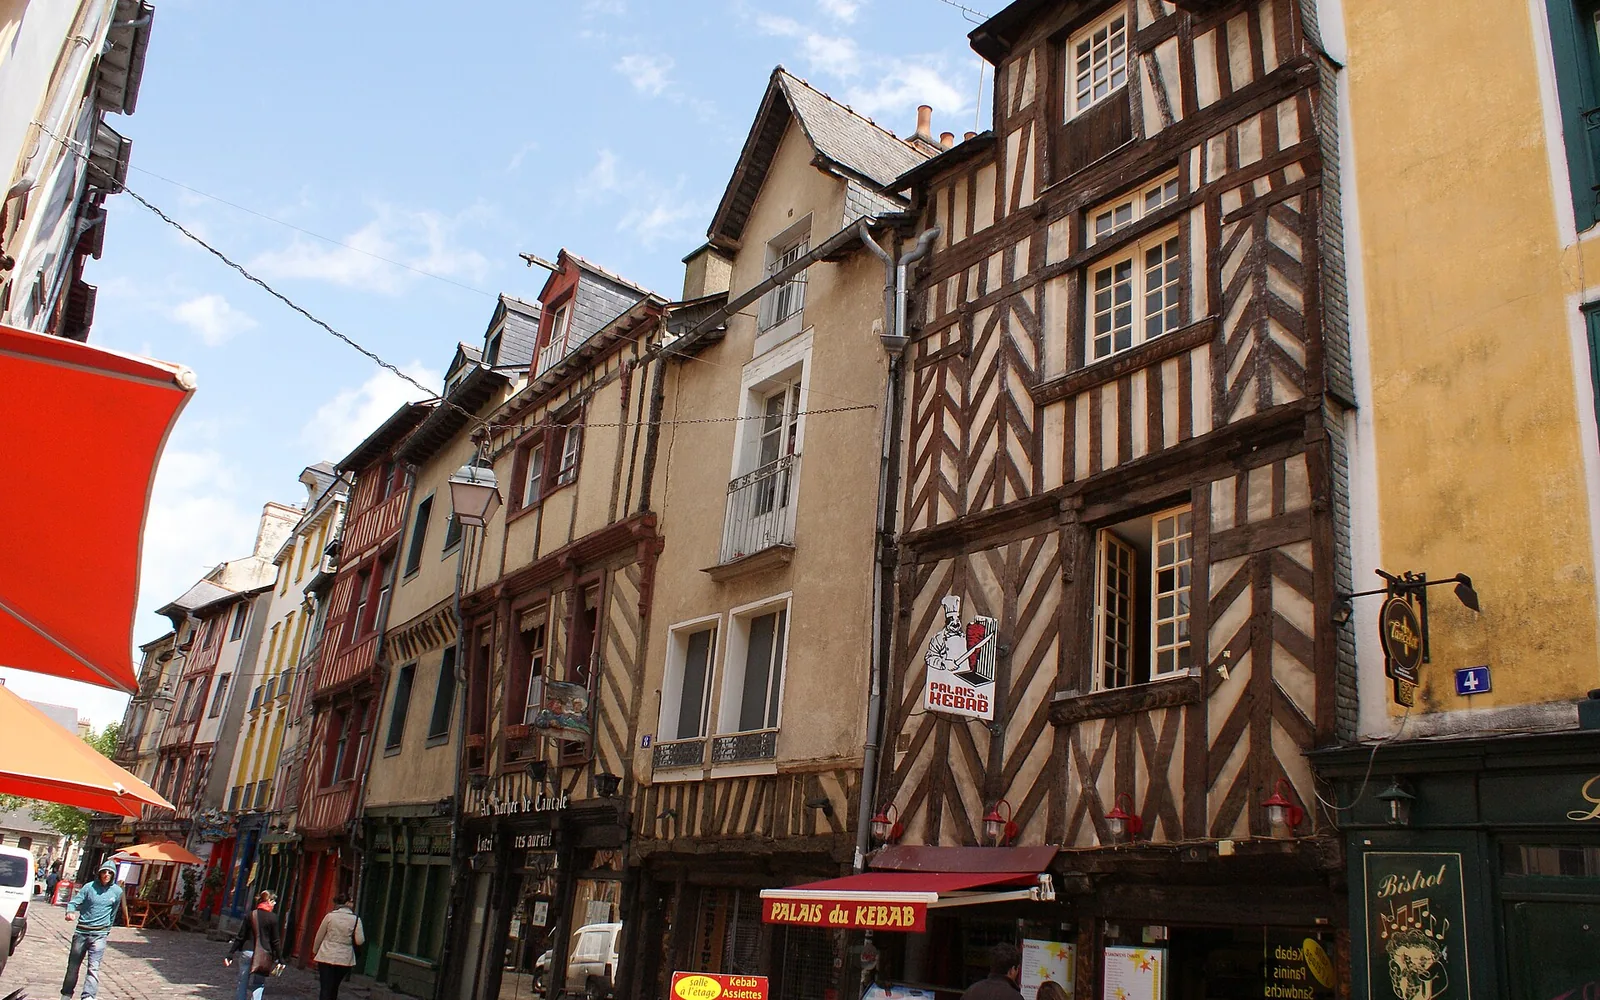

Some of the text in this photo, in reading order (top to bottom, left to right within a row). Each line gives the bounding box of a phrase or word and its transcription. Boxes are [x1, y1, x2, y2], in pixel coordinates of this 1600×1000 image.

[1464, 672, 1479, 690] 4
[930, 682, 988, 701] PALAIS du
[929, 692, 989, 713] KEBAB
[522, 794, 531, 813] de
[535, 789, 568, 812] Cancale
[1377, 864, 1446, 898] Bistrot
[770, 902, 915, 927] PALAIS du KEBAB
[689, 977, 709, 987] salle
[729, 977, 757, 988] Kebab
[688, 986, 716, 999] l'étage
[722, 988, 762, 1000] Assiettes
